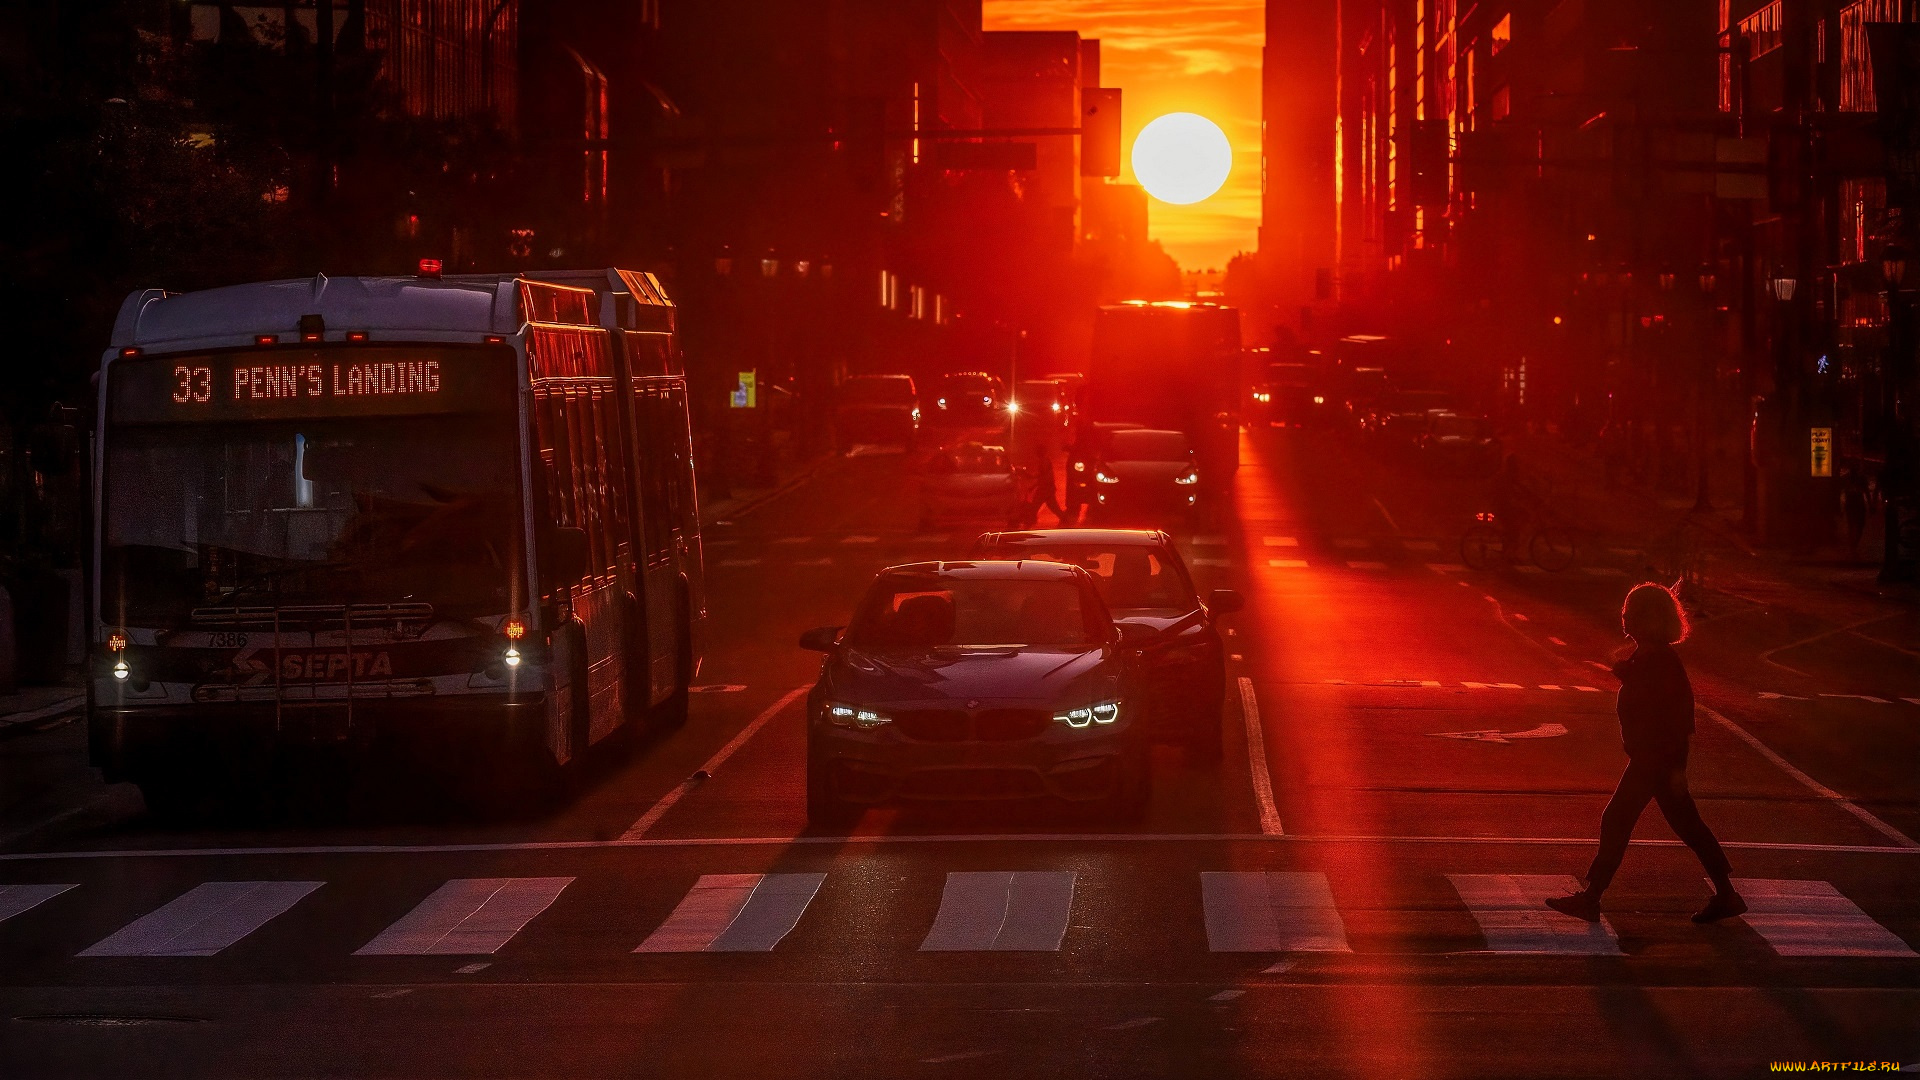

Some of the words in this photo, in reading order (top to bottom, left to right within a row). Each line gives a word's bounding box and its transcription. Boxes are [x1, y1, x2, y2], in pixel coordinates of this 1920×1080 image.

[173, 366, 211, 403] 33
[235, 364, 323, 399] PENN'S
[333, 361, 440, 396] LANDING
[207, 632, 249, 648] 7386
[281, 650, 392, 679] SEPTA
